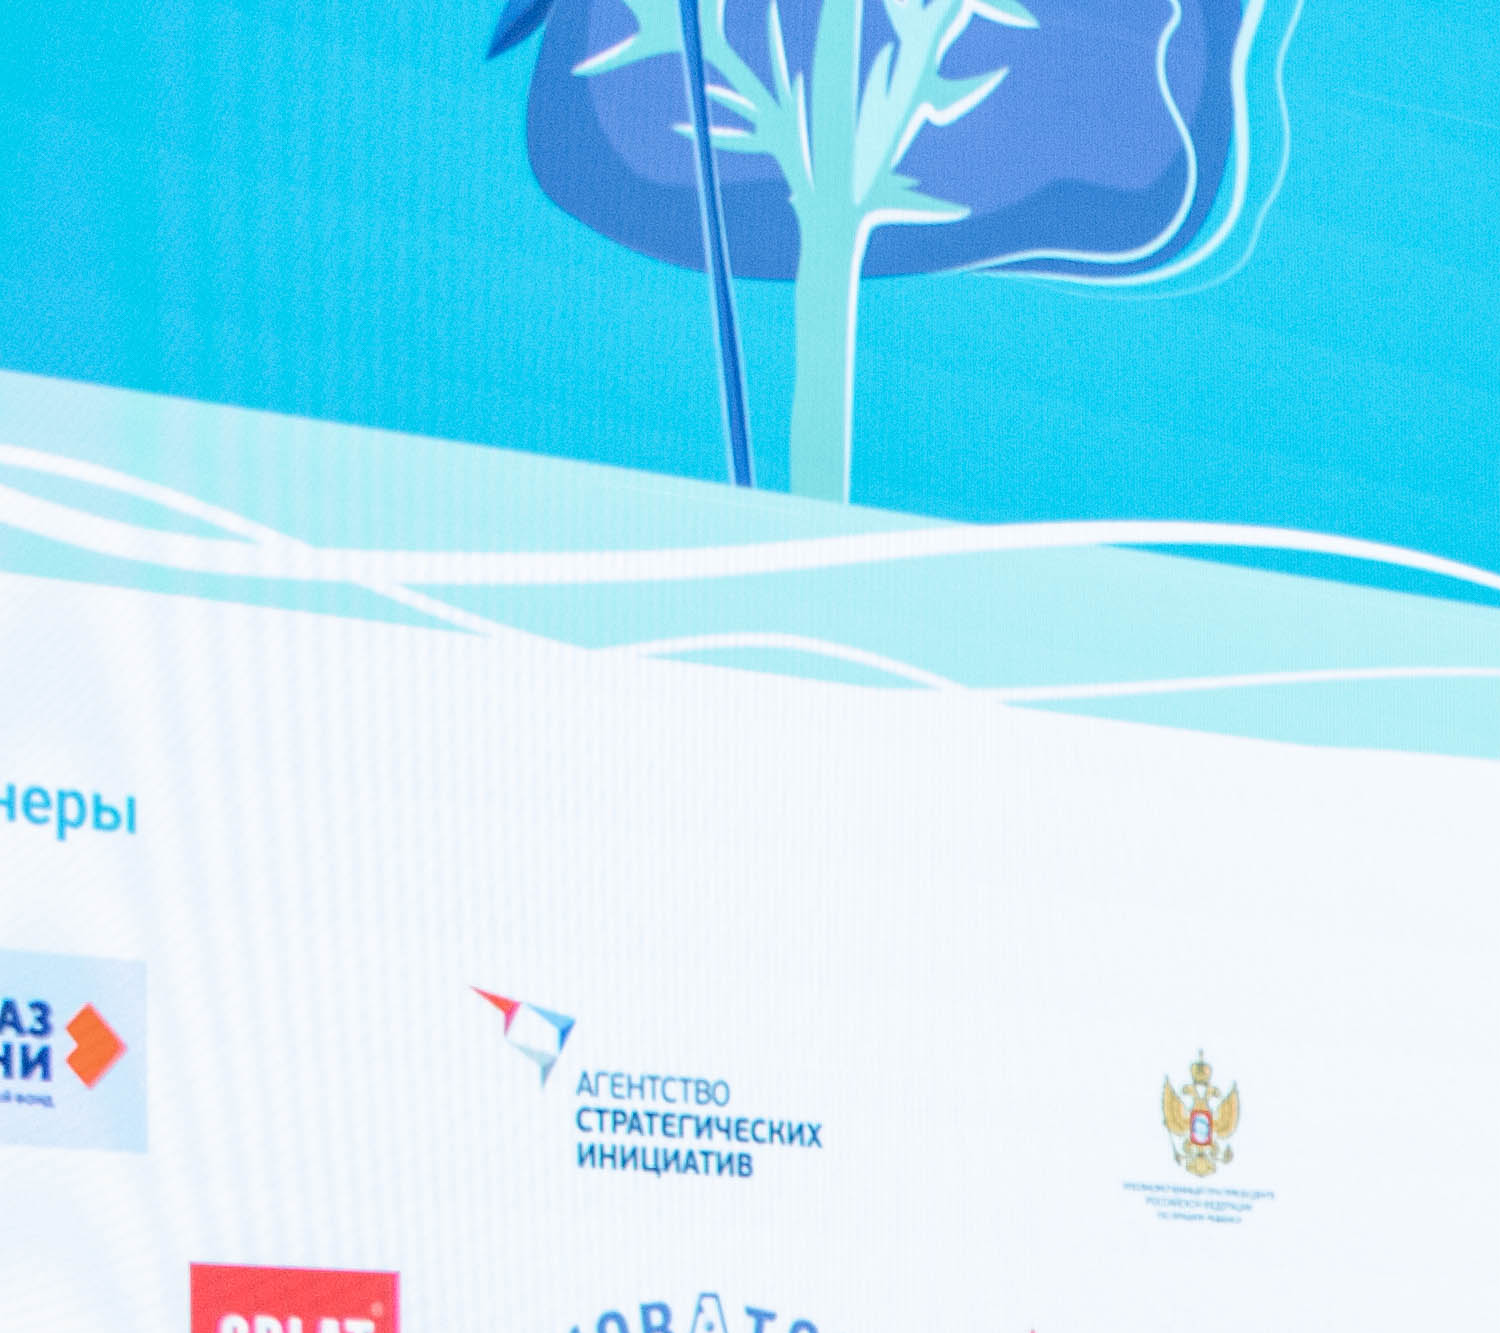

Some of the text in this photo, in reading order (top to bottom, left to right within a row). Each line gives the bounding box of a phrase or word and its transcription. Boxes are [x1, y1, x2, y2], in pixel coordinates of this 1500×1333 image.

[576, 1070, 732, 1107] АГЕНТСТВО
[575, 1104, 824, 1150] СТРАТЕГИЧЕСКИХ
[575, 1142, 754, 1181] ИНИЦИАТИВ
